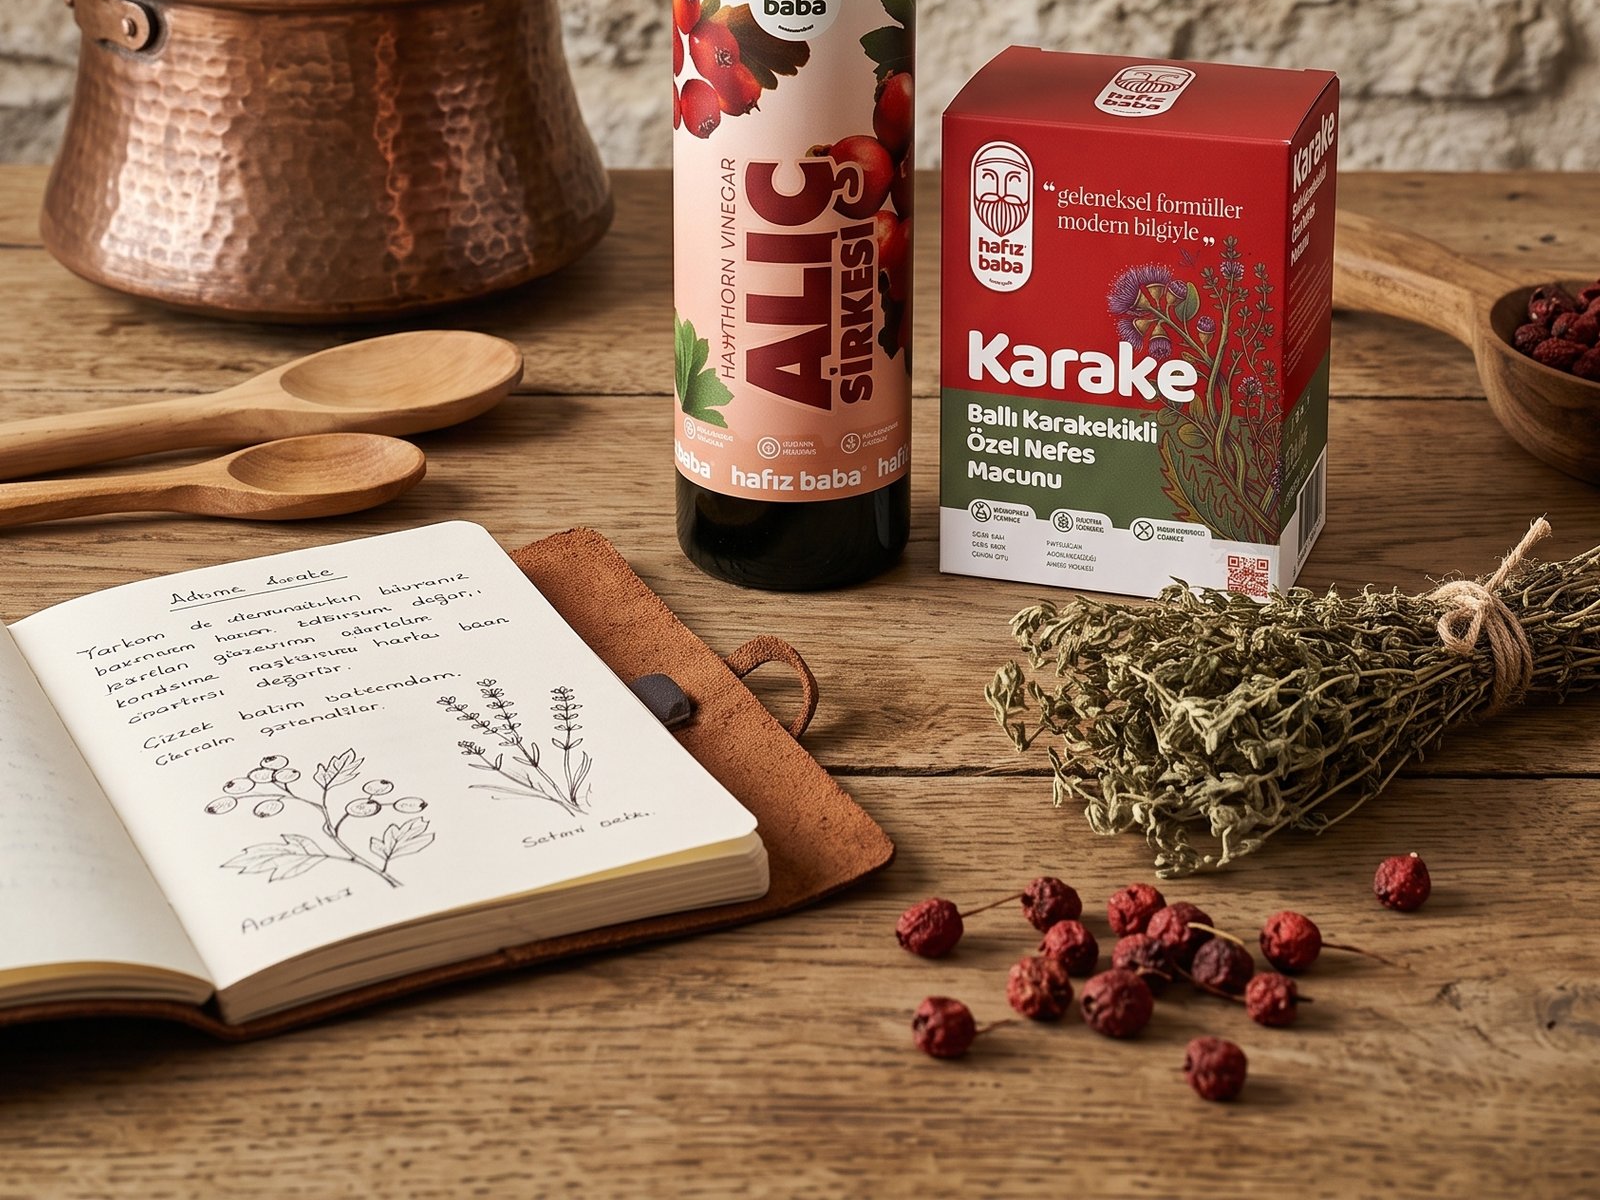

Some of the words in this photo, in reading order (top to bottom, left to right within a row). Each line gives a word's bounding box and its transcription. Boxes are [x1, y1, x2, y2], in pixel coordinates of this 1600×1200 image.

[1103, 99, 1161, 110] baba
[1293, 111, 1335, 193] Karake
[721, 158, 737, 249] VINEGAR
[1156, 193, 1243, 219] formüller
[1057, 213, 1130, 235] modern
[979, 254, 1023, 274] baba
[967, 329, 1199, 404] Karake
[967, 403, 1018, 428] Ballı
[1022, 409, 1158, 444] Karakekikli
[966, 426, 1019, 457] Özel
[1024, 438, 1096, 465] Nefes
[800, 468, 862, 492] baba
[967, 460, 1062, 490] Macunu
